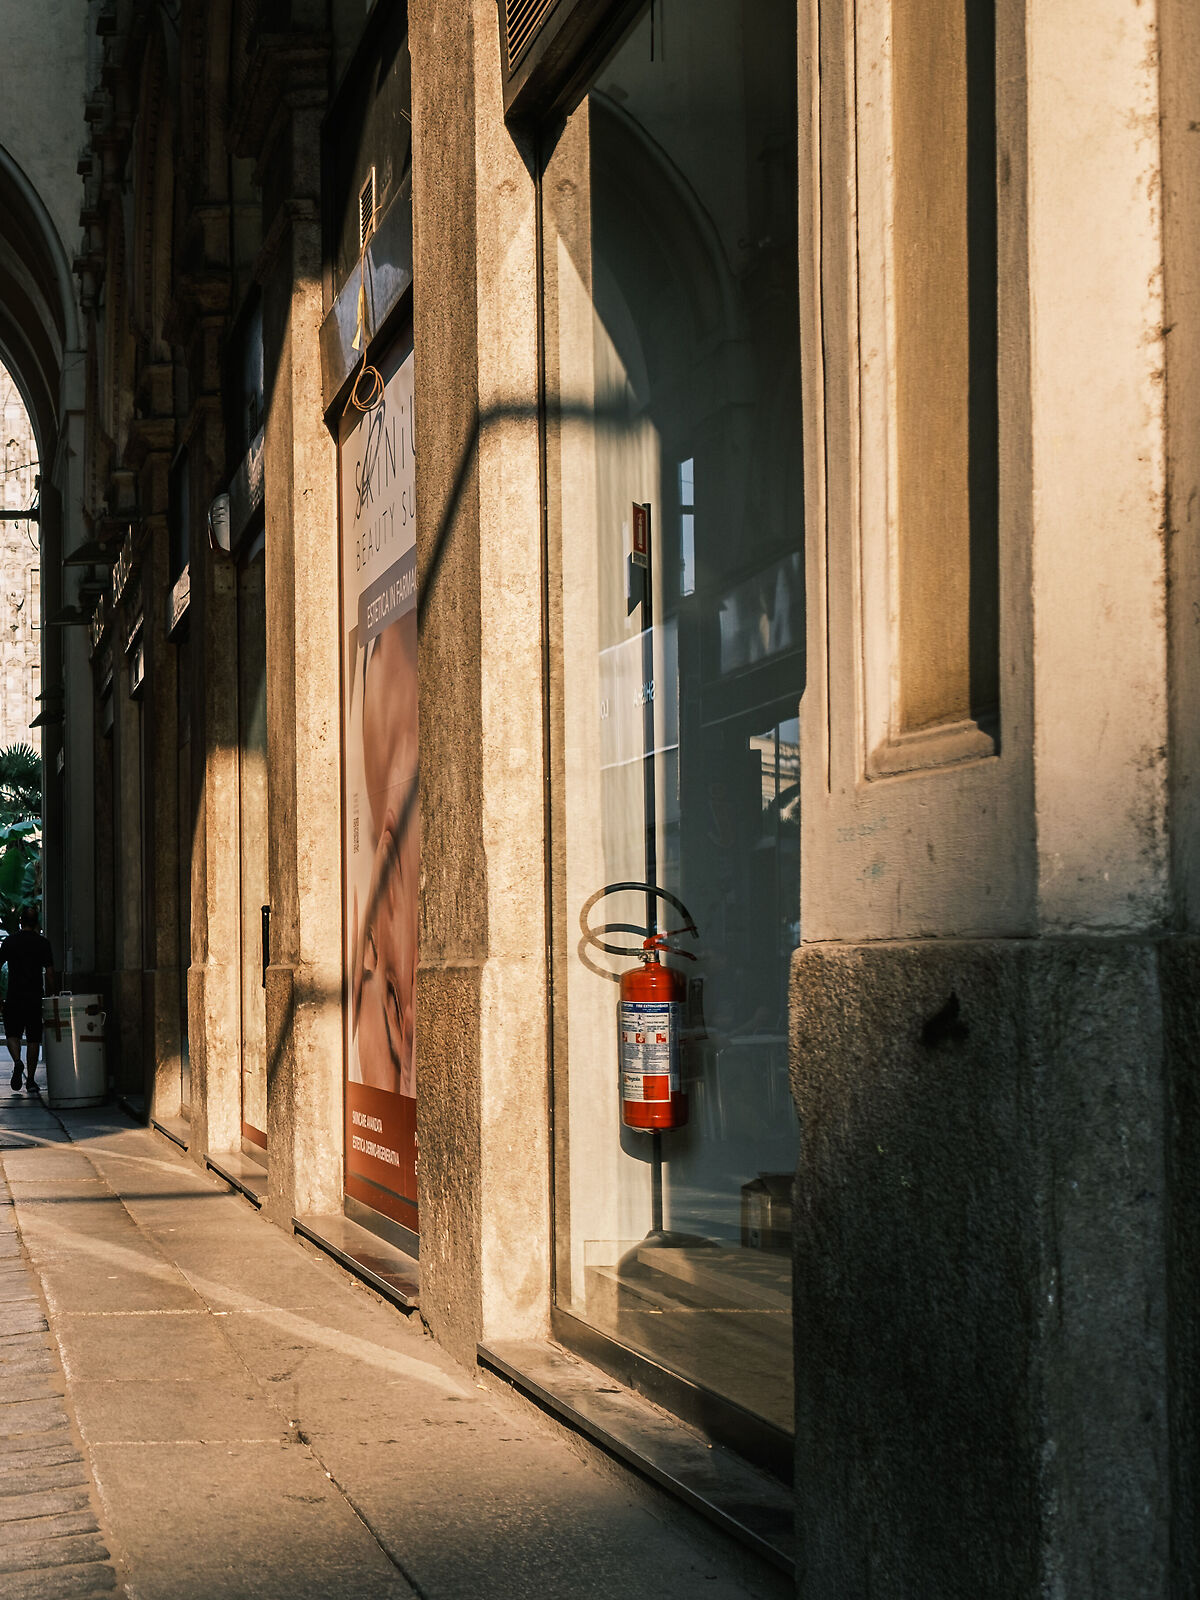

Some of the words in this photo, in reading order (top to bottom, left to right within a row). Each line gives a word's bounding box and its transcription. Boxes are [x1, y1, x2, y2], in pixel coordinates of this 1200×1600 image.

[355, 502, 395, 572] BEAUTY
[367, 590, 390, 629] ESTETICA
[352, 1135, 365, 1153] ESTETICA
